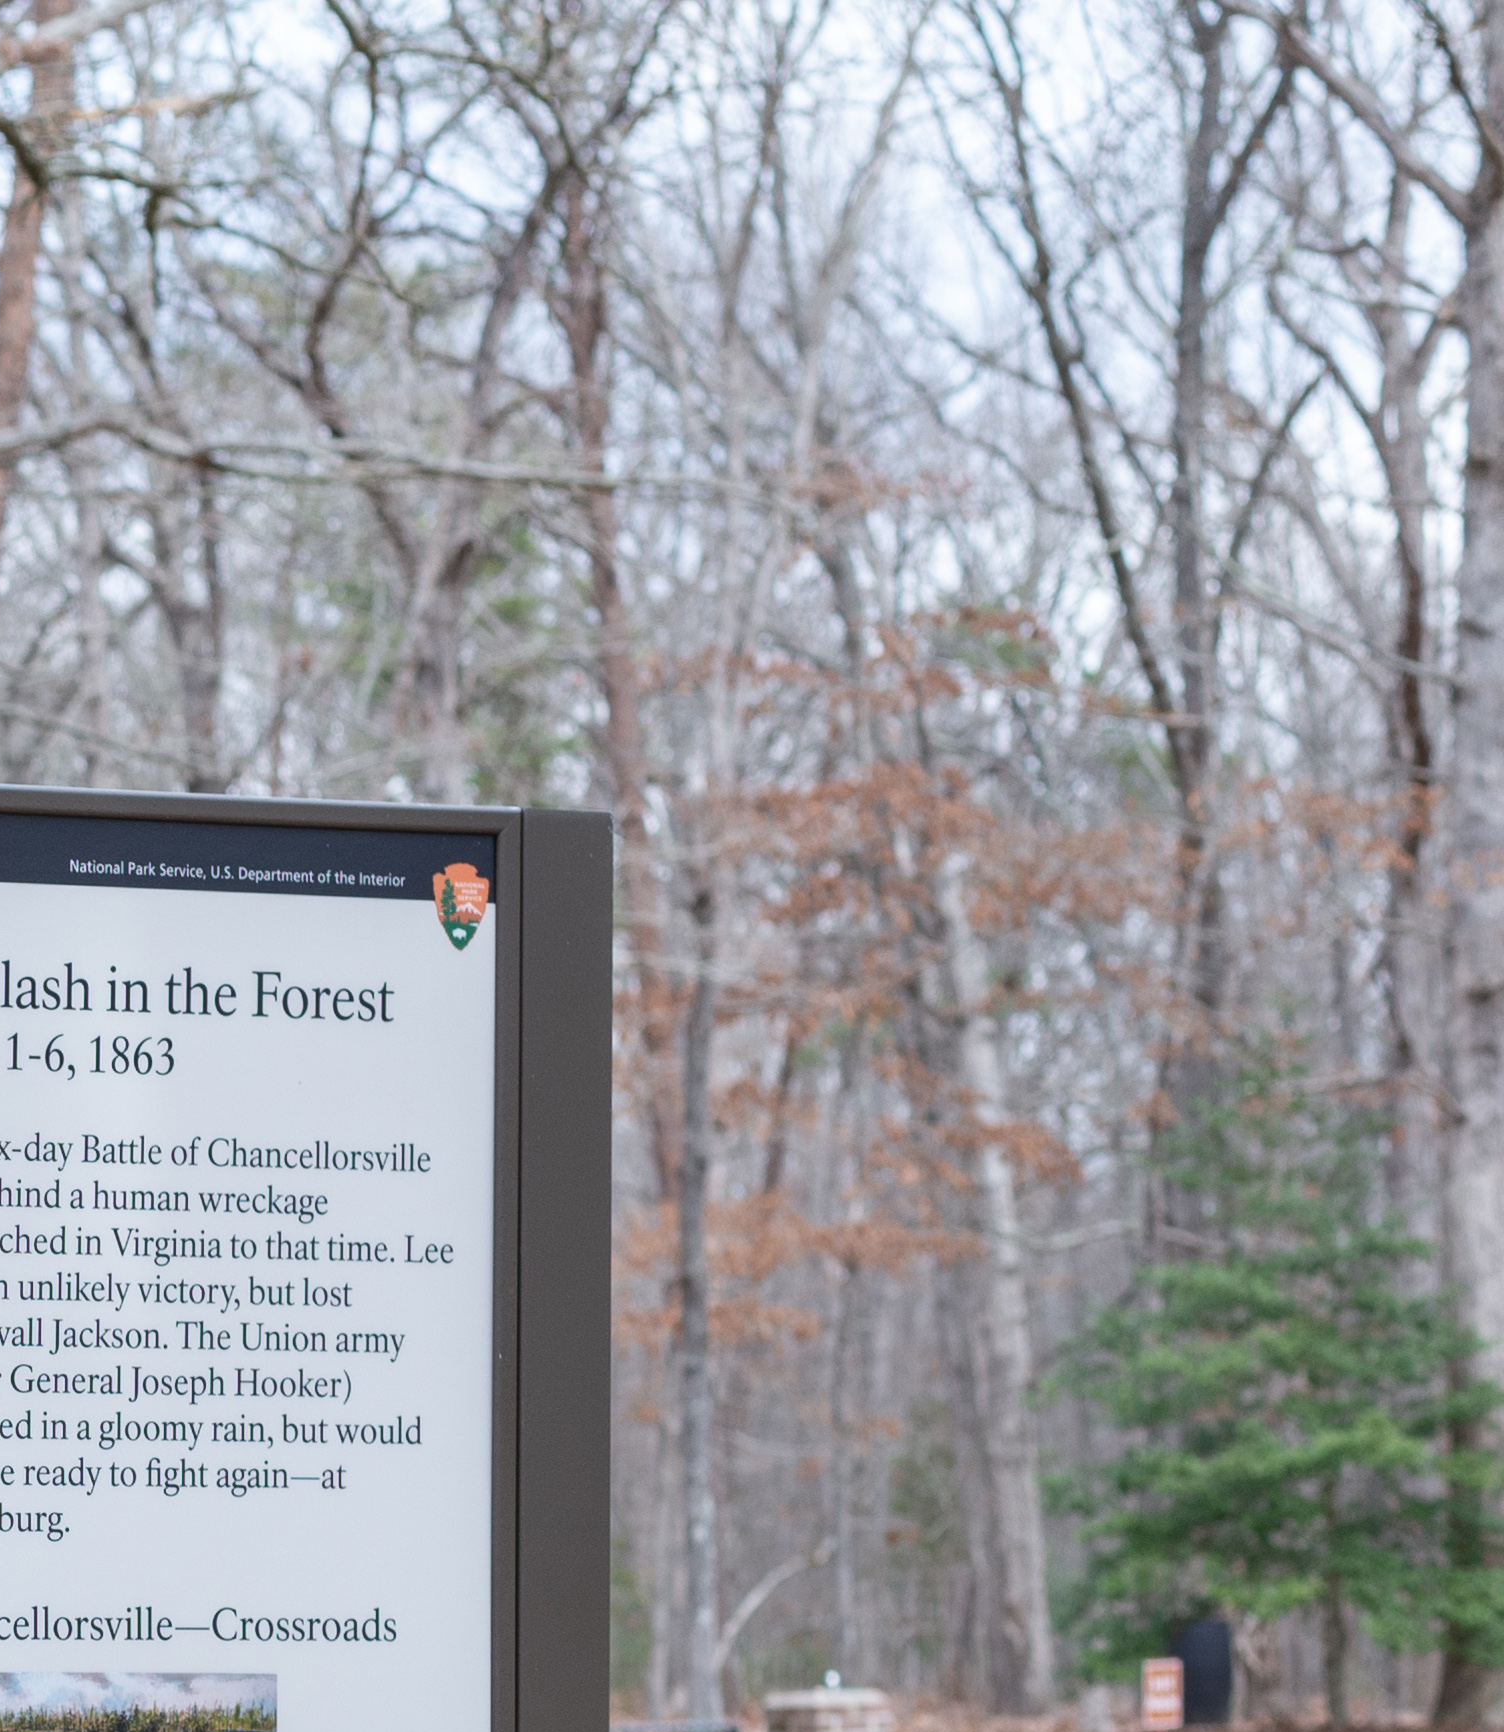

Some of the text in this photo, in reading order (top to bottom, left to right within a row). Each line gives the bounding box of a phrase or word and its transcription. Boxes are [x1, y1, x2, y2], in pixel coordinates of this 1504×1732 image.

[69, 858, 406, 887] National Park Service, U.S. Department of the Interior
[106, 965, 152, 1014] in
[164, 966, 237, 1017] the
[251, 970, 395, 1023] Forest
[7, 1032, 76, 1081] 1-6,
[90, 1035, 175, 1076] 1863
[81, 1134, 162, 1166] Battle
[170, 1136, 202, 1166] of
[207, 1137, 431, 1173] Chancellorsville
[69, 1188, 85, 1210] a
[93, 1179, 190, 1212] human
[198, 1184, 328, 1225] wreckage
[75, 1226, 102, 1256] in
[111, 1227, 223, 1267] Virginia
[230, 1234, 257, 1260] to
[265, 1230, 320, 1261] that
[327, 1233, 395, 1263] time.
[404, 1234, 454, 1265] Lee
